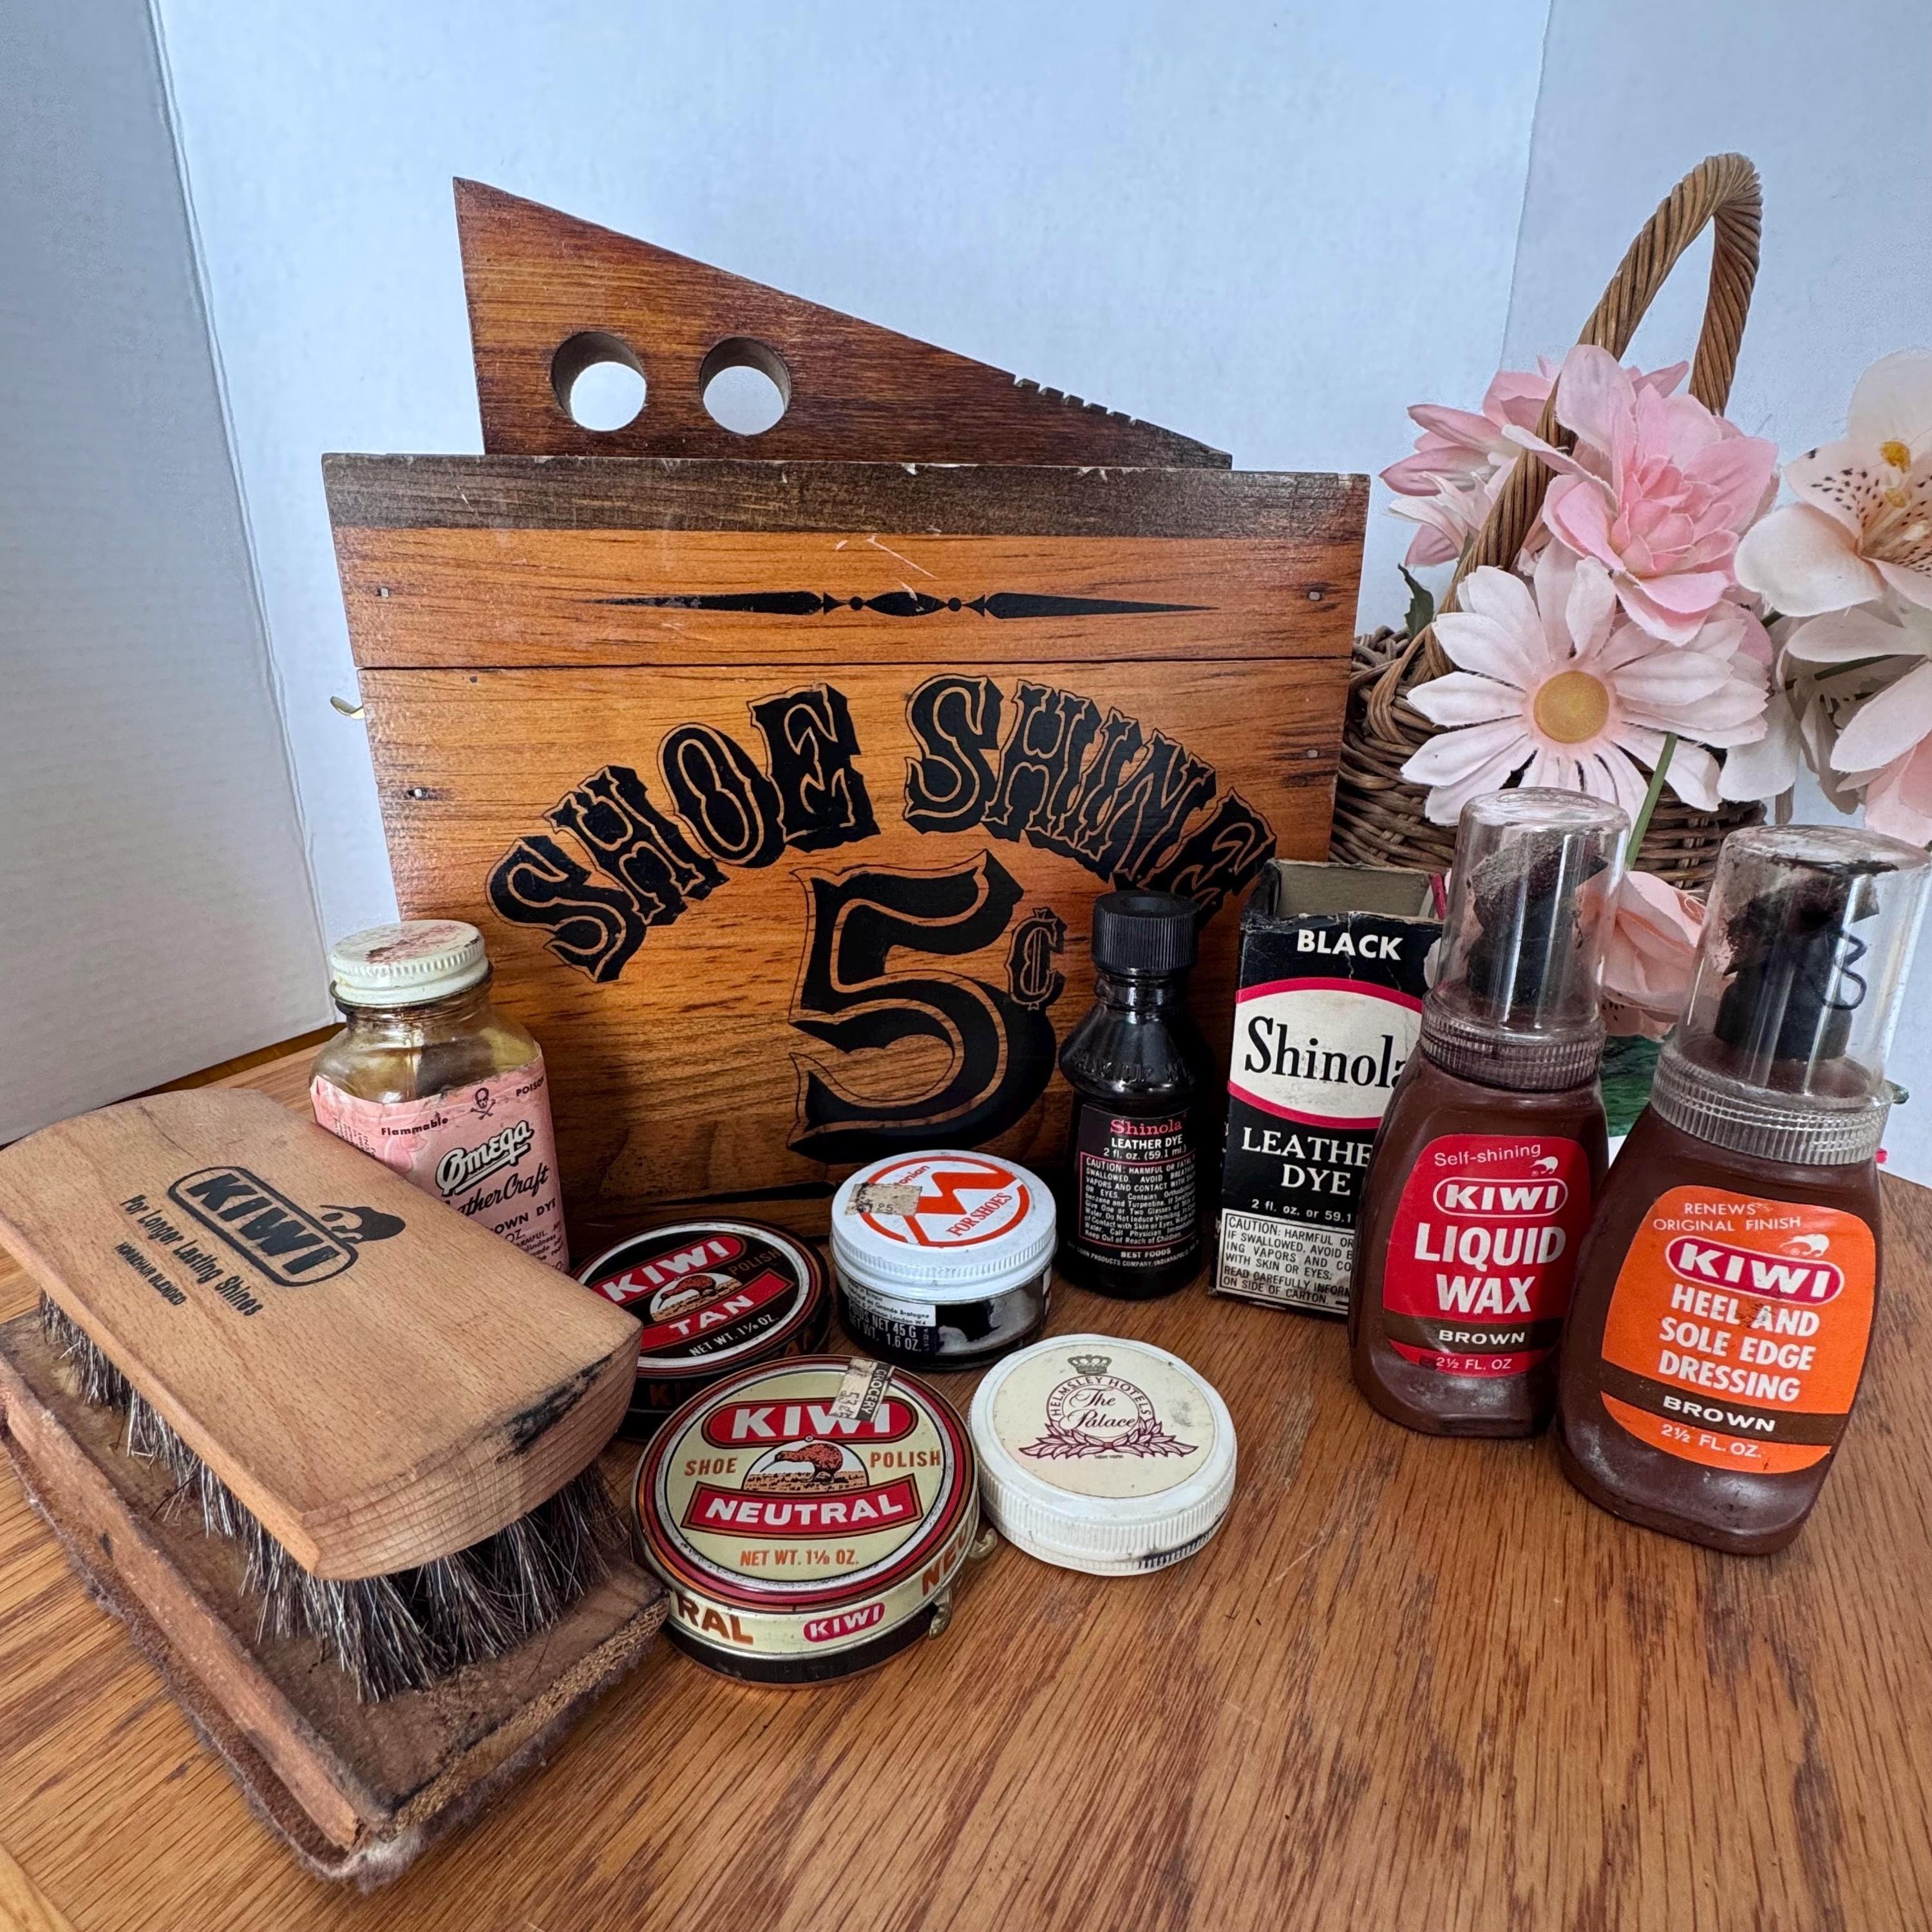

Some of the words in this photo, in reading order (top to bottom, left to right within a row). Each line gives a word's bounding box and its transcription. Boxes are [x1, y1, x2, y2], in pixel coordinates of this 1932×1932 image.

[486, 683, 882, 983] SHOE
[904, 674, 1277, 921] SHINE
[1296, 929, 1404, 961] BLACK
[381, 1115, 448, 1136] Flammable
[1110, 1119, 1182, 1135] Shinola
[1104, 1148, 1110, 1157] 2
[1113, 1150, 1123, 1159] fl.
[1144, 1148, 1168, 1160] (59.1
[1112, 1137, 1161, 1150] LEATHER
[1166, 1134, 1183, 1147] DYE
[1242, 1126, 1373, 1168] LEATHE
[436, 1119, 535, 1196] Omega
[1086, 1157, 1126, 1173] CAUTION:
[1166, 1164, 1175, 1172] OR
[1434, 1144, 1541, 1167] Self-shining
[1085, 1185, 1094, 1194] OR
[1086, 1176, 1112, 1189] VAPORS
[1115, 1183, 1132, 1192] AND
[1133, 1182, 1168, 1193] CONTACT
[1170, 1177, 1186, 1189] WITH
[1141, 1175, 1163, 1184] AVOID
[1281, 1163, 1351, 1196] DYE
[536, 1197, 556, 1217] DYE
[1101, 1204, 1115, 1213] One
[1251, 1198, 1260, 1209] 2
[1265, 1200, 1277, 1212] fl.
[1282, 1206, 1300, 1216] oz.
[1305, 1209, 1319, 1218] or
[1324, 1210, 1352, 1223] 59.1
[1444, 1184, 1559, 1211] KIWI
[1684, 1202, 1757, 1215] RENEWS
[186, 1173, 341, 1276] KIWI
[946, 1215, 974, 1236] FOR
[970, 1192, 1013, 1224] SHOES
[1092, 1217, 1116, 1228] Contact
[1134, 1222, 1149, 1231] Skin
[1105, 1212, 1115, 1220] Do
[1117, 1215, 1129, 1223] Not
[1131, 1215, 1154, 1224] Induce
[1653, 1218, 1735, 1232] ORIGINAL
[1745, 1217, 1801, 1231] FINISH
[1102, 1233, 1114, 1242] Out
[1110, 1227, 1123, 1236] Call
[1130, 1229, 1162, 1239] Physician
[1227, 1230, 1236, 1239] IF
[1310, 1245, 1342, 1258] AVOID
[1228, 1216, 1281, 1236] CAUTION:
[1284, 1228, 1333, 1245] HARMFUL
[1340, 1237, 1353, 1248] OR
[119, 1195, 149, 1215] For
[138, 1209, 185, 1245] Longer
[173, 1238, 225, 1283] Lasting
[214, 1274, 264, 1317] Shines
[1090, 1253, 1121, 1267] PRODUCTS
[1144, 1247, 1171, 1258] FOODS
[1226, 1241, 1245, 1253] ING
[1253, 1246, 1297, 1263] VAPORS
[1304, 1255, 1328, 1267] AND
[1414, 1222, 1566, 1272] LIQUID
[602, 1240, 730, 1302] KIWI
[728, 1248, 782, 1276] POLISH
[1225, 1252, 1251, 1265] WITH
[1255, 1258, 1280, 1271] SKIN
[1285, 1264, 1299, 1274] OR
[1678, 1242, 1831, 1298] KIWI
[1223, 1276, 1238, 1286] ON
[1241, 1279, 1265, 1293] SIDE
[1268, 1284, 1282, 1296] OF
[1285, 1289, 1329, 1305] CARTON.
[1224, 1265, 1249, 1278] READ
[1253, 1271, 1311, 1291] CAREFULLY
[1436, 1273, 1535, 1314] WAX
[669, 1294, 755, 1336] TAN
[900, 1309, 929, 1320] Bretagne
[1670, 1283, 1740, 1325] HEEL
[1752, 1306, 1820, 1337] AND
[689, 1340, 713, 1357] NET
[714, 1331, 737, 1347] WT.
[759, 1314, 779, 1329] OZ.
[872, 1314, 890, 1333] NET
[893, 1323, 906, 1337] 45
[908, 1325, 917, 1338] G
[1438, 1329, 1526, 1345] BROWN
[886, 1332, 902, 1349] 1.6
[904, 1338, 922, 1352] OZ.
[1659, 1316, 1731, 1357] SOLE
[1739, 1336, 1816, 1371] EDGE
[1436, 1356, 1459, 1369] 2½
[1465, 1358, 1486, 1370] FL.
[1491, 1358, 1513, 1370] OZ
[1658, 1349, 1801, 1402] DRESSING
[861, 1369, 887, 1415] GROCERY
[1050, 1376, 1103, 1417] HELMSLEY
[1108, 1378, 1152, 1416] HOTELS
[1068, 1387, 1117, 1407] The
[731, 1403, 889, 1439] KIWI
[1059, 1409, 1136, 1428] Palace
[1663, 1396, 1776, 1432] BROWN
[1660, 1424, 1690, 1443] 2½
[1698, 1433, 1726, 1452] FL.
[1730, 1442, 1763, 1459] OZ.
[684, 1457, 737, 1477] SHOE
[870, 1447, 941, 1468] POLISH
[705, 1494, 903, 1526] NEUTRAL
[740, 1550, 768, 1567] NET
[774, 1550, 802, 1566] WT.
[837, 1549, 860, 1566] OZ.
[808, 1605, 880, 1639] KIWI
